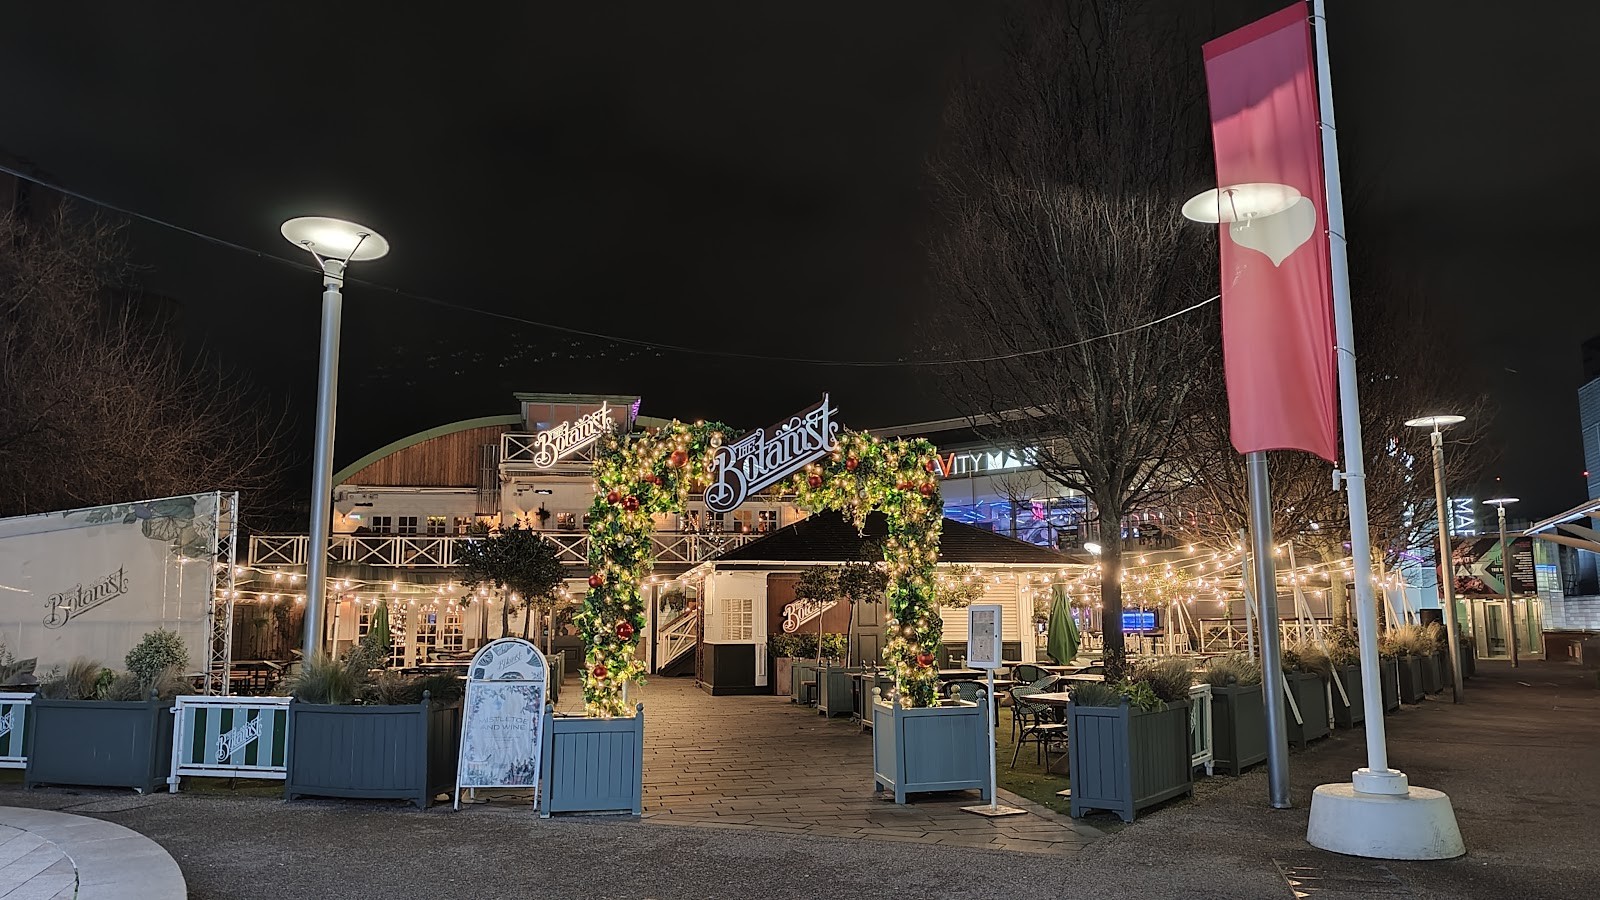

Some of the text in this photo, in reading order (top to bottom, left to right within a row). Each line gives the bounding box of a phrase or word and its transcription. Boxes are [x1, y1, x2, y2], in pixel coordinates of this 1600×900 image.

[534, 401, 612, 468] Botanist
[705, 393, 839, 512] Botanist
[735, 440, 758, 460] THE
[986, 446, 1039, 471] MAX
[43, 563, 129, 630] Botanist
[216, 711, 262, 762] Botanist
